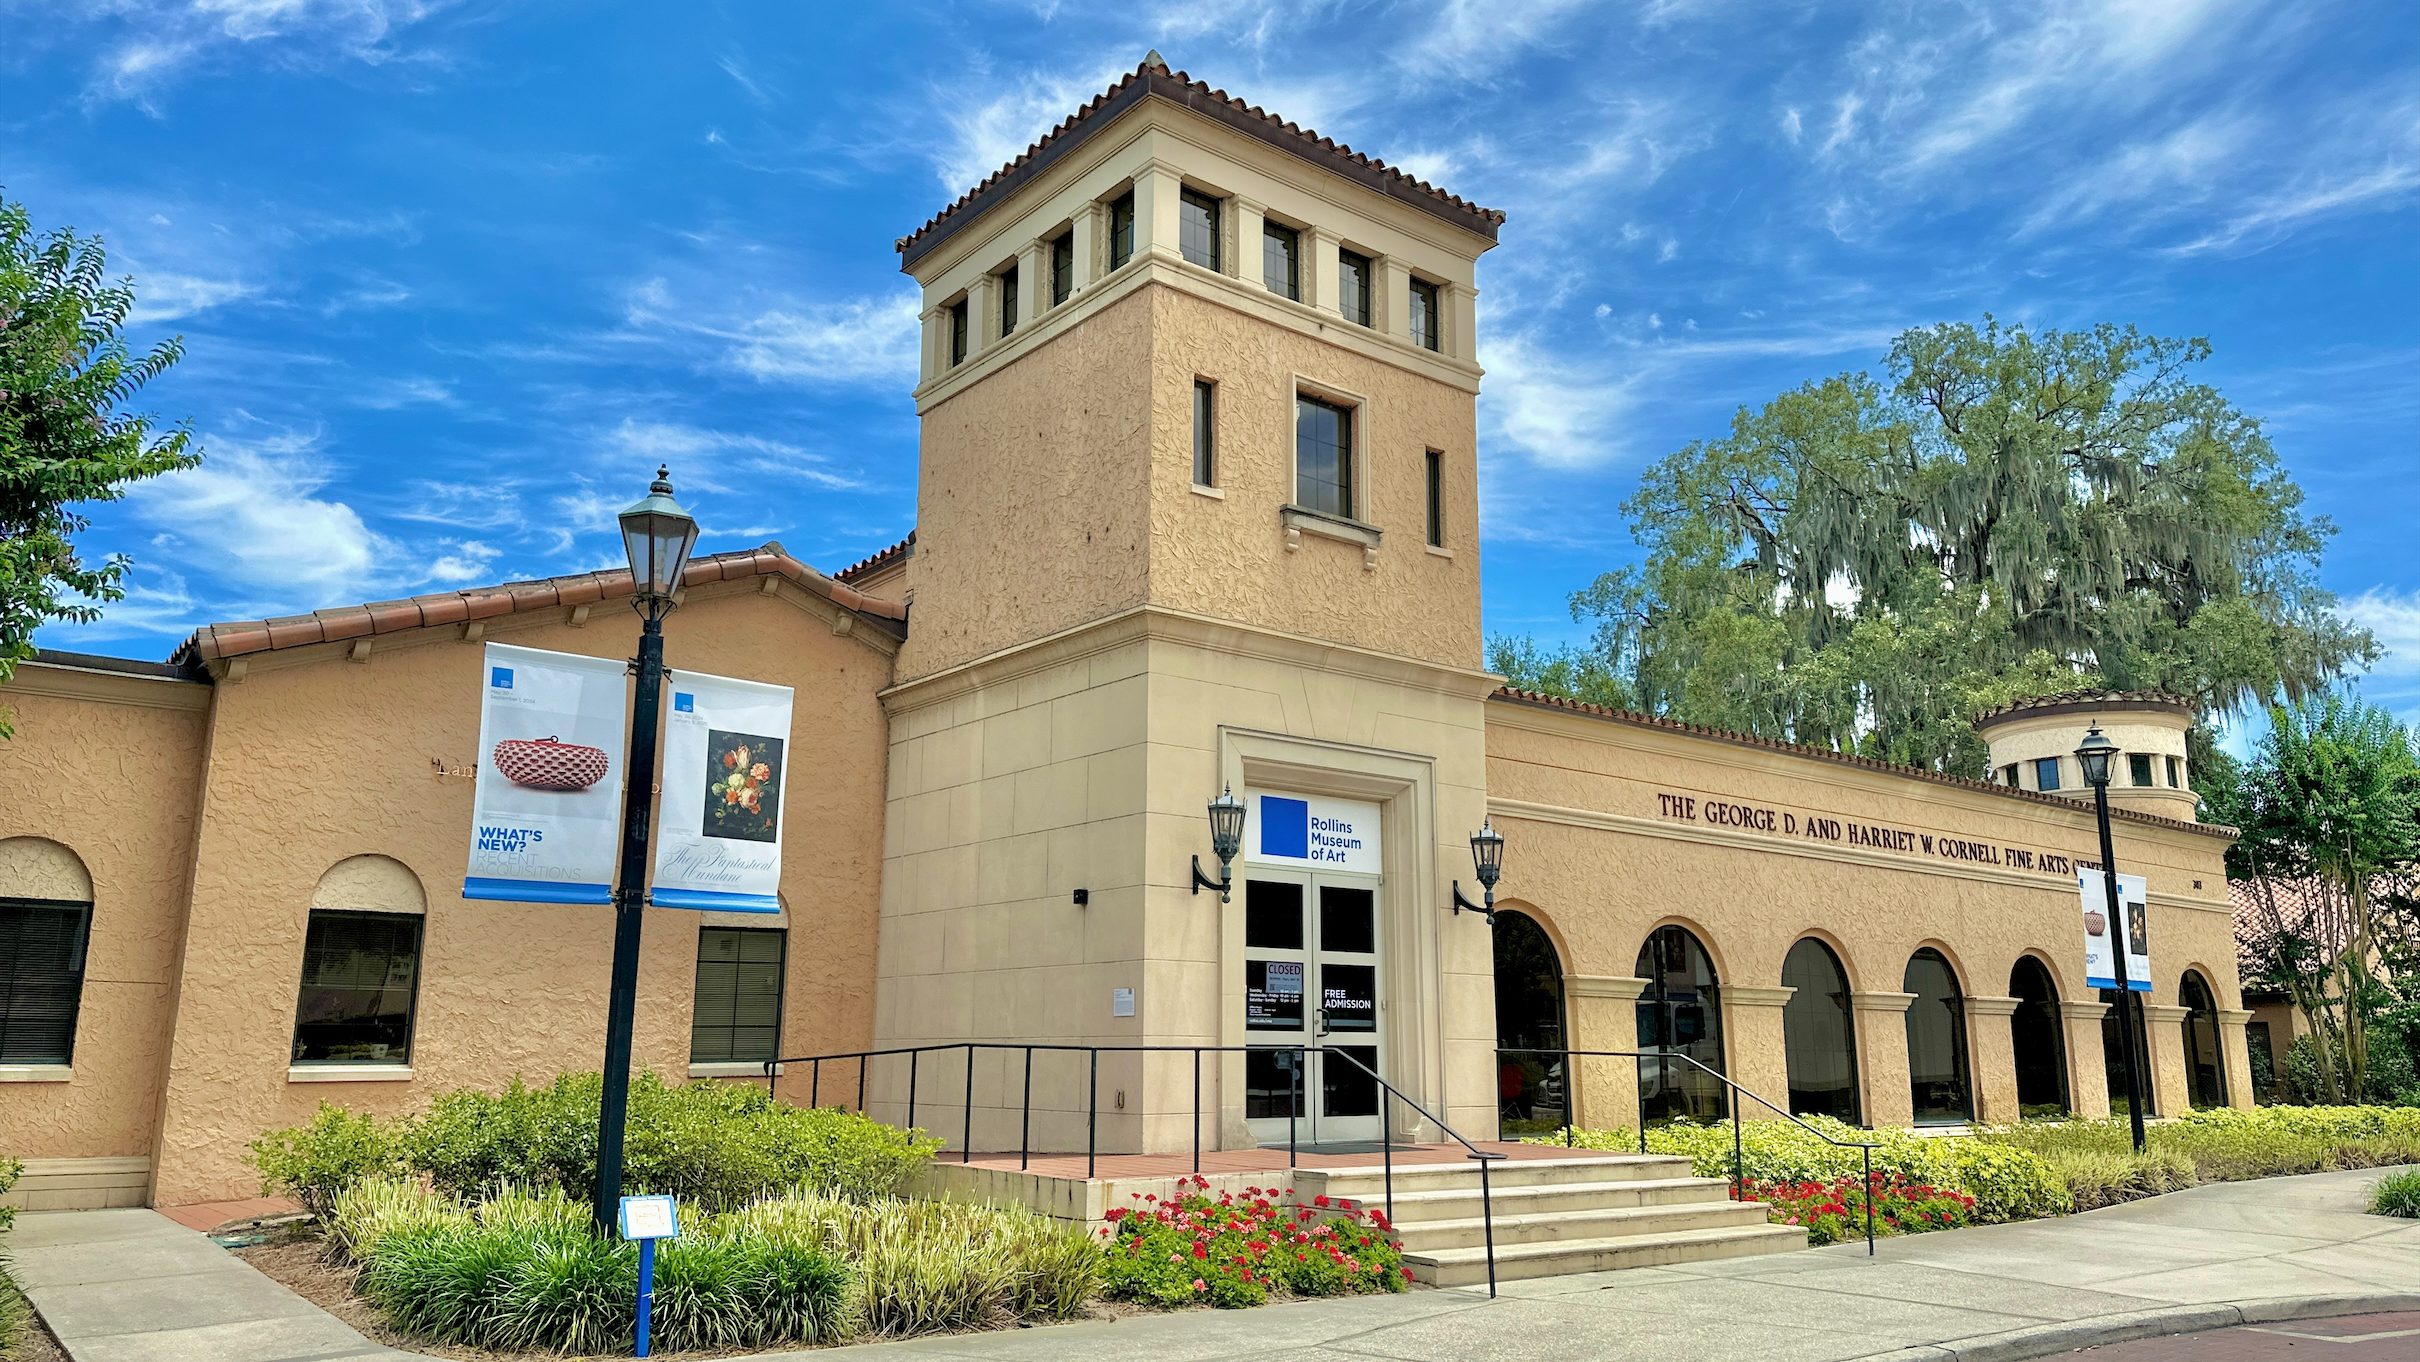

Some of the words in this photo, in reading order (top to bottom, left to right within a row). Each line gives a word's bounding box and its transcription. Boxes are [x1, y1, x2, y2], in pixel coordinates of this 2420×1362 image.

[1311, 817, 1353, 834] Rollins
[479, 826, 543, 842] WHAT'S
[1311, 832, 1362, 850] Museum
[1658, 793, 1696, 820] THE
[1704, 801, 1777, 832] GEORGE
[1783, 813, 1799, 836] D.
[1806, 816, 1842, 840] AND
[1847, 823, 1916, 851] HARRIET
[1919, 834, 1935, 855] W.
[1939, 838, 2001, 865] CORNELL
[2004, 847, 2034, 870] FINE
[2038, 853, 2069, 875] ARTS
[477, 839, 527, 853] NEW?
[476, 850, 540, 865] RECENT
[1311, 847, 1325, 861] of
[1326, 848, 1346, 863] Art
[474, 862, 582, 881] ACQUISITIONS
[1268, 964, 1301, 975] CLOSED
[1325, 989, 1346, 998] FREE
[1325, 999, 1371, 1009] ADMISSION
